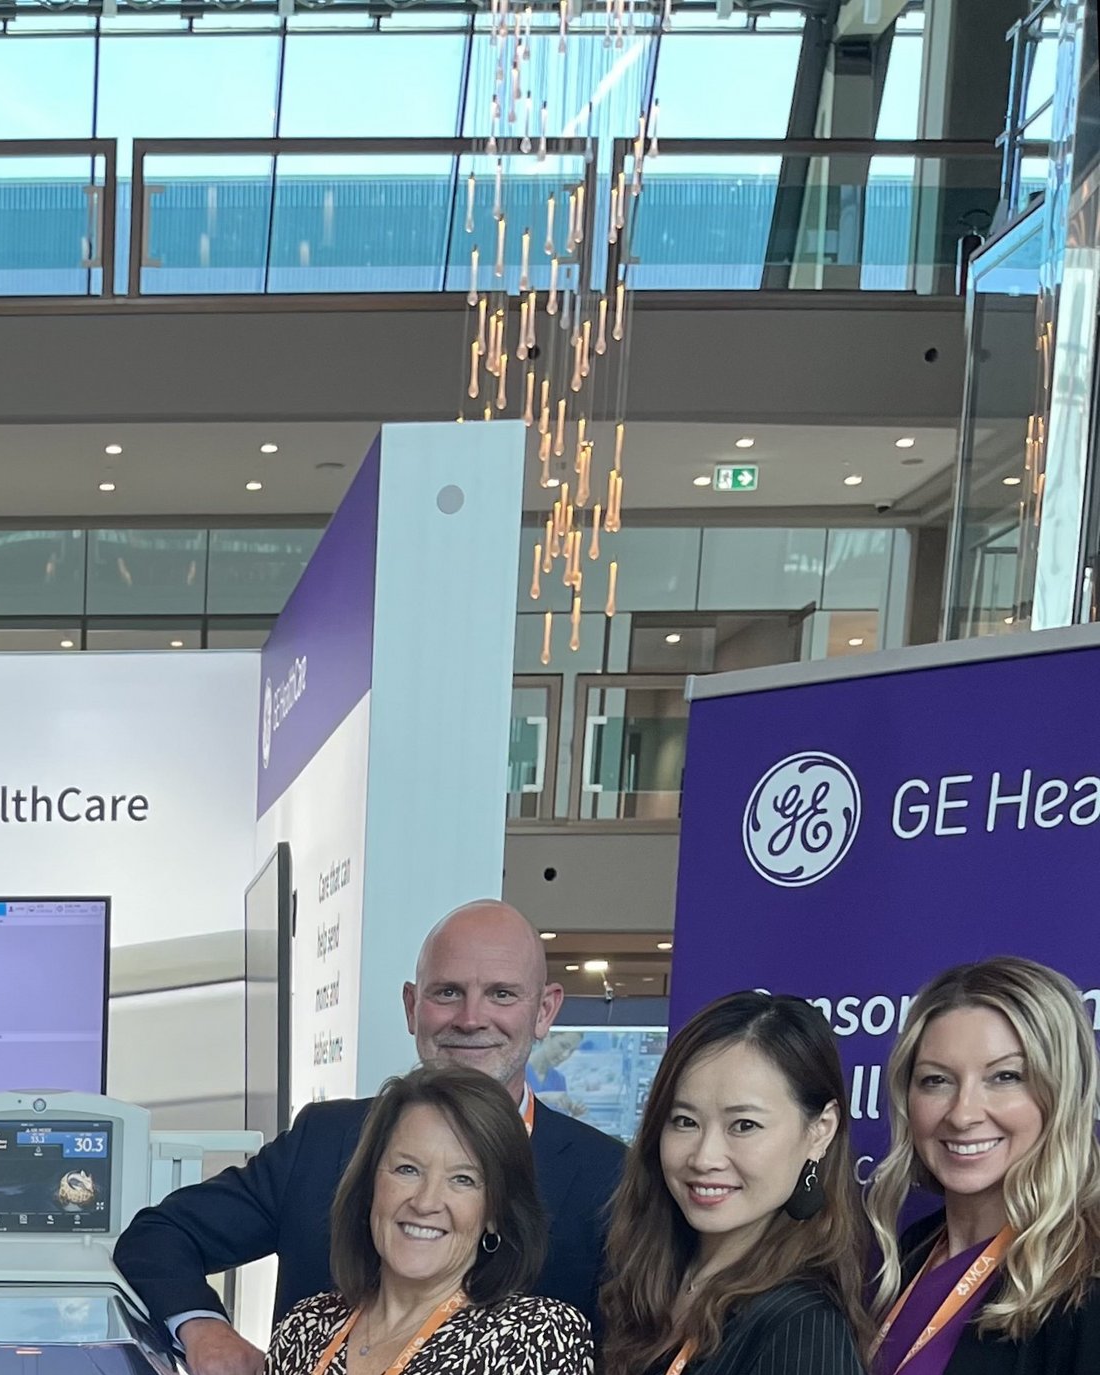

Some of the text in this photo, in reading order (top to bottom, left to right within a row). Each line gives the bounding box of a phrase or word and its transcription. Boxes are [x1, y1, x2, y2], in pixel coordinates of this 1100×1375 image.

[891, 774, 973, 840] GE
[74, 1137, 104, 1152] 30.3
[964, 1254, 996, 1287] MCA
[393, 1345, 418, 1371] MCA
